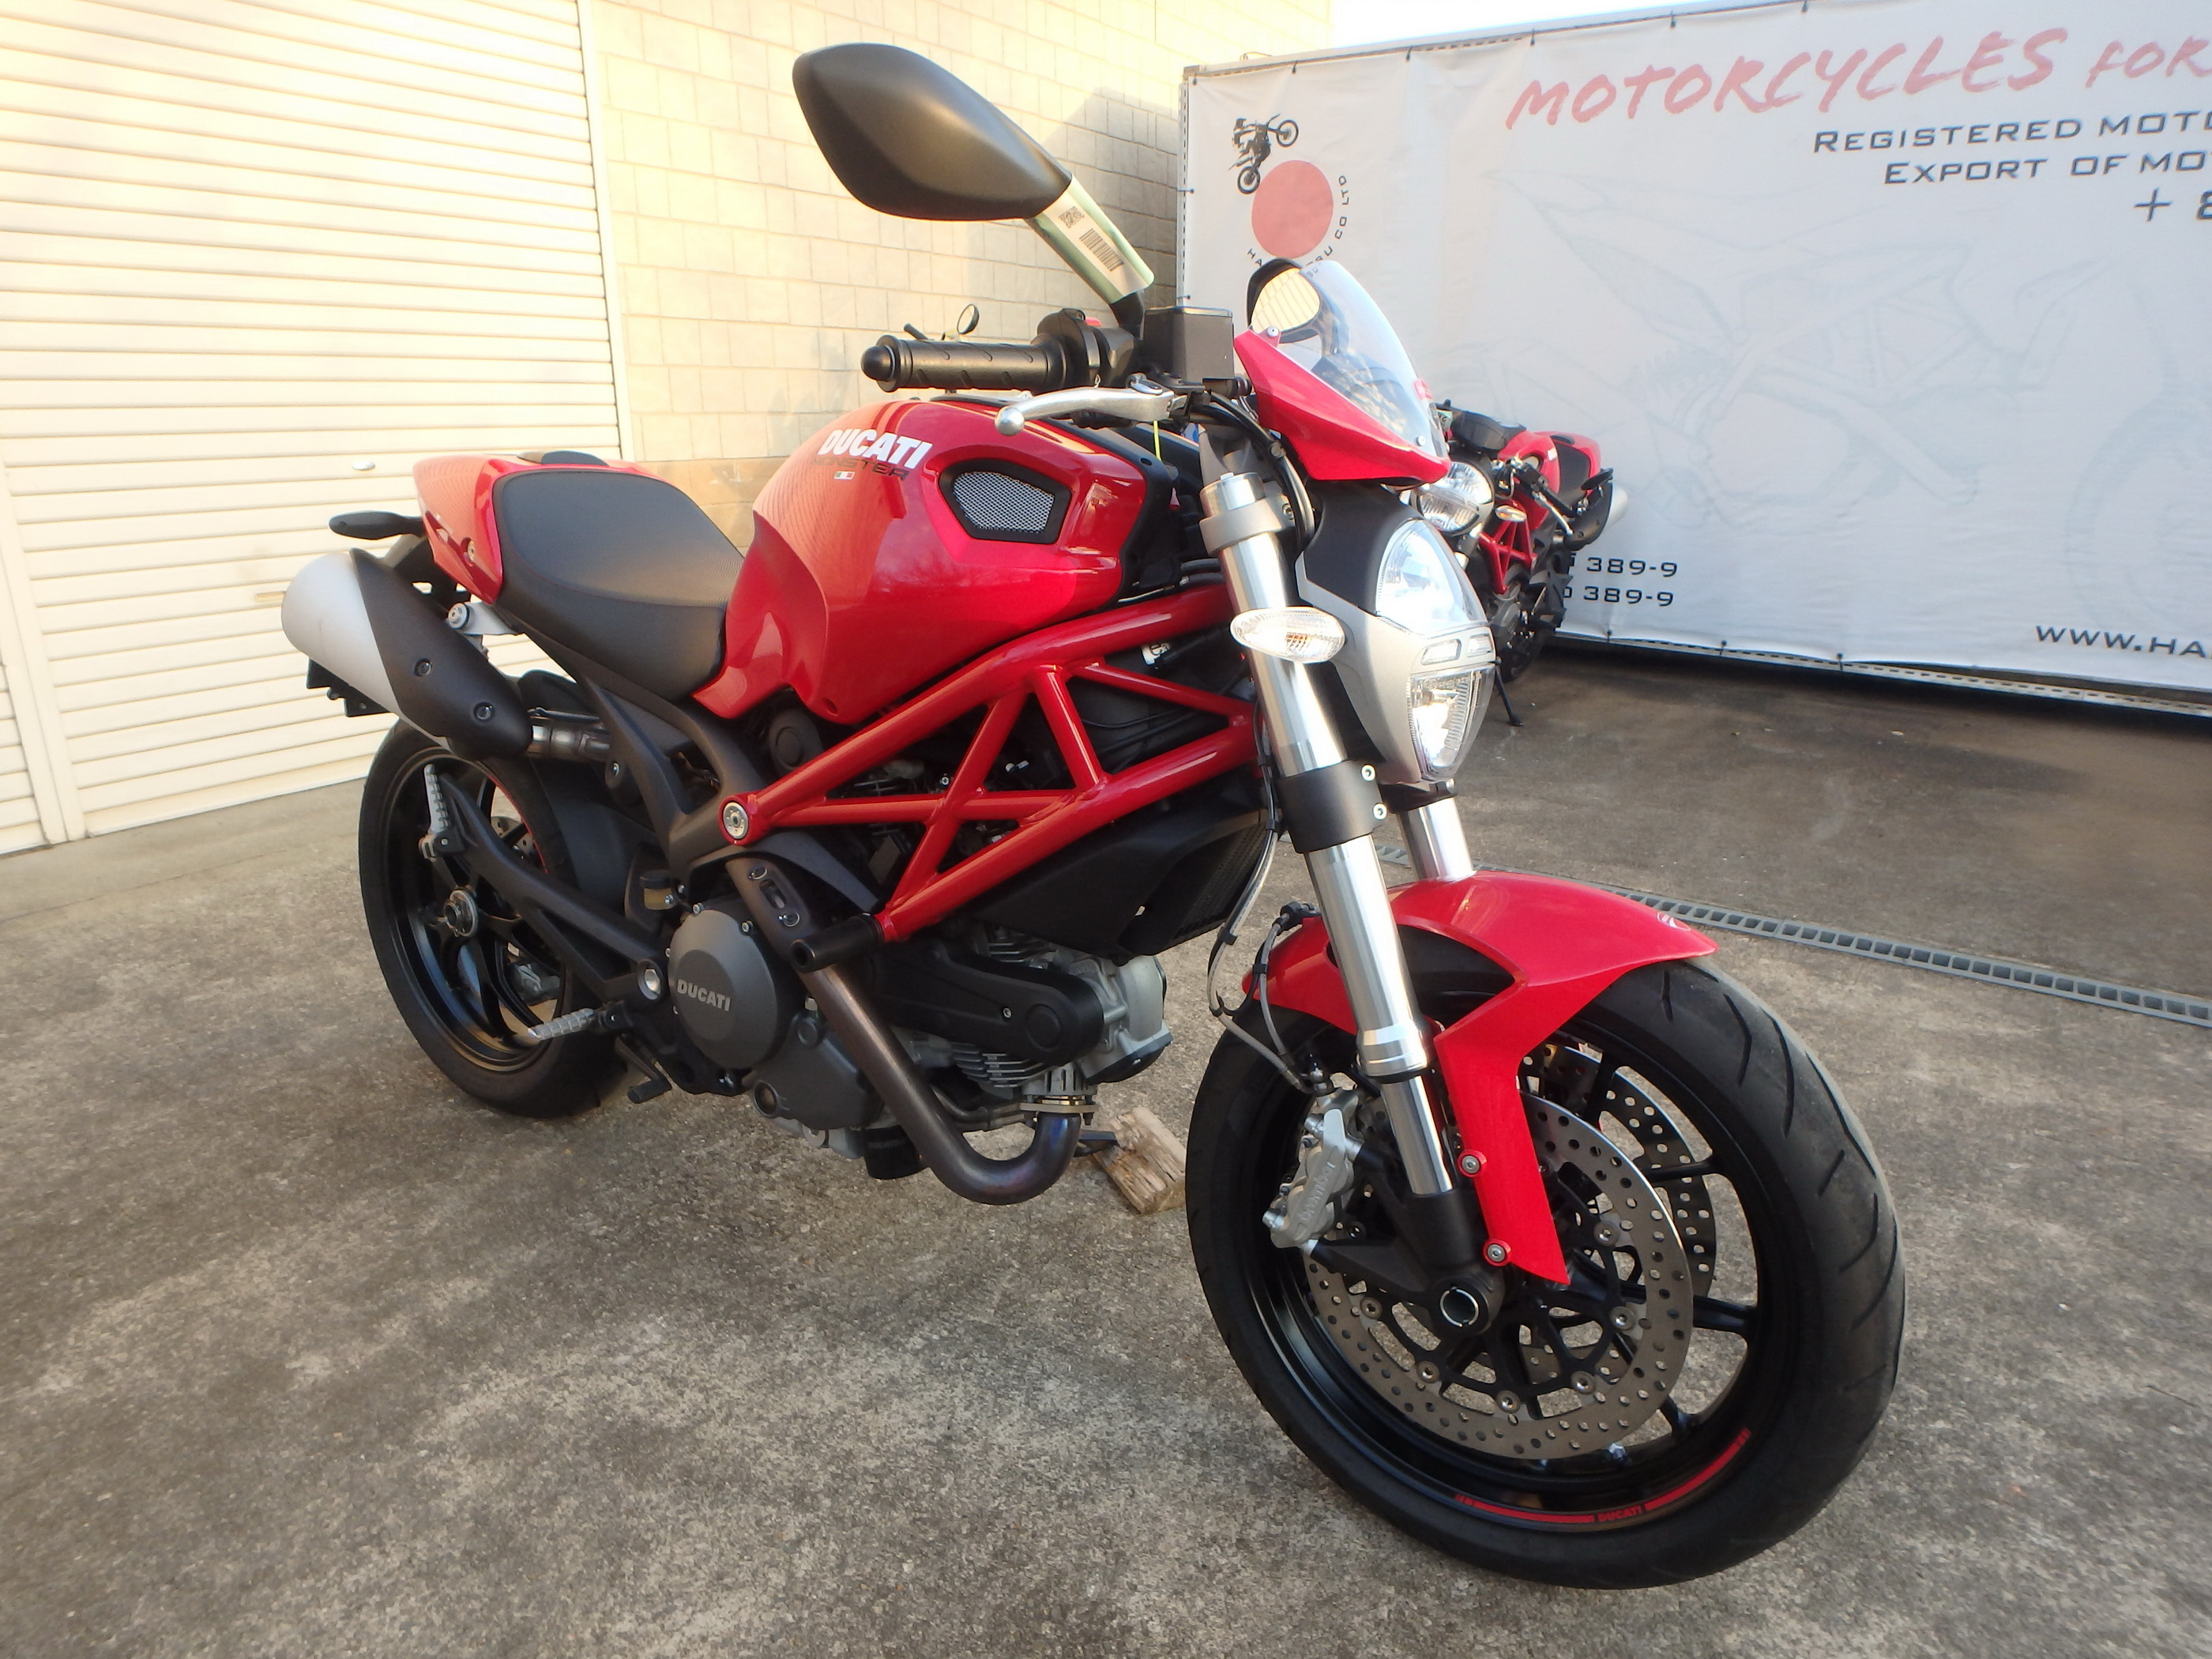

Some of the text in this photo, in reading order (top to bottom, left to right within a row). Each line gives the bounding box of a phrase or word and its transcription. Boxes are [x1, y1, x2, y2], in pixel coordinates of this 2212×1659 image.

[1506, 28, 2067, 130] MOTORCYCLES
[1813, 118, 2082, 153] REGISTERED
[1884, 150, 2212, 185] EXPORT OF MO
[817, 428, 933, 469] DUCATI
[1586, 557, 1677, 577] 389-9
[1583, 585, 1674, 607] 389-9
[2036, 625, 2212, 659] WWW.HA
[677, 979, 731, 1012] DUCATI
[1597, 1504, 1642, 1522] DUCATI
